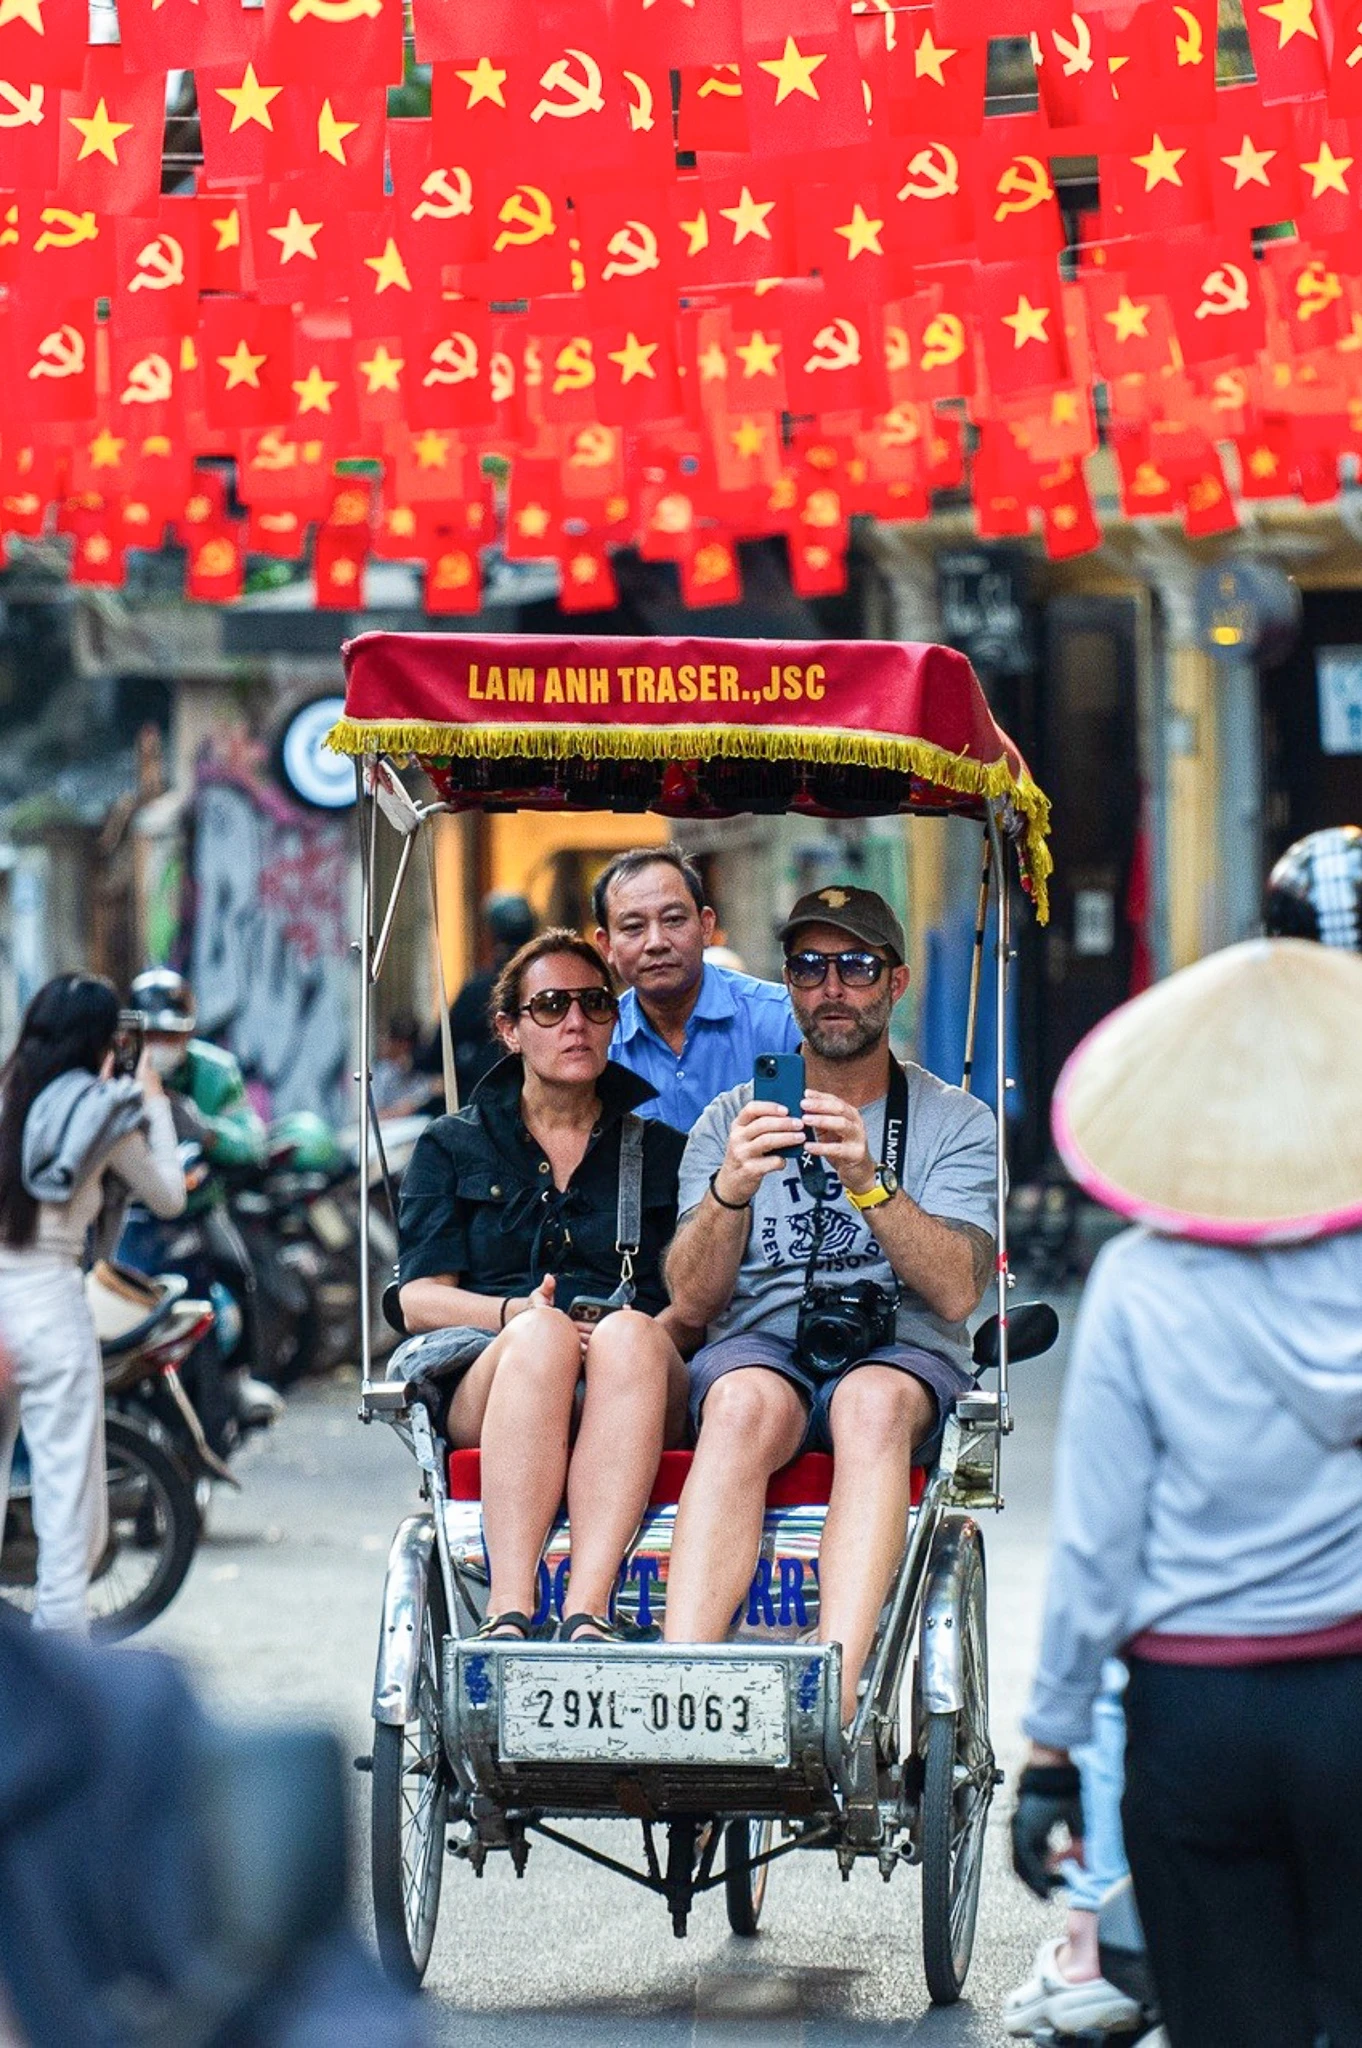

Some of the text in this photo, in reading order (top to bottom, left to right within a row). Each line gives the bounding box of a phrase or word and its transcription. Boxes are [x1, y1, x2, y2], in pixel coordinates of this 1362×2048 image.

[469, 664, 535, 702] LAM
[543, 667, 609, 703] ANH
[886, 1119, 902, 1172] LUMIX
[761, 1217, 785, 1267] FREN
